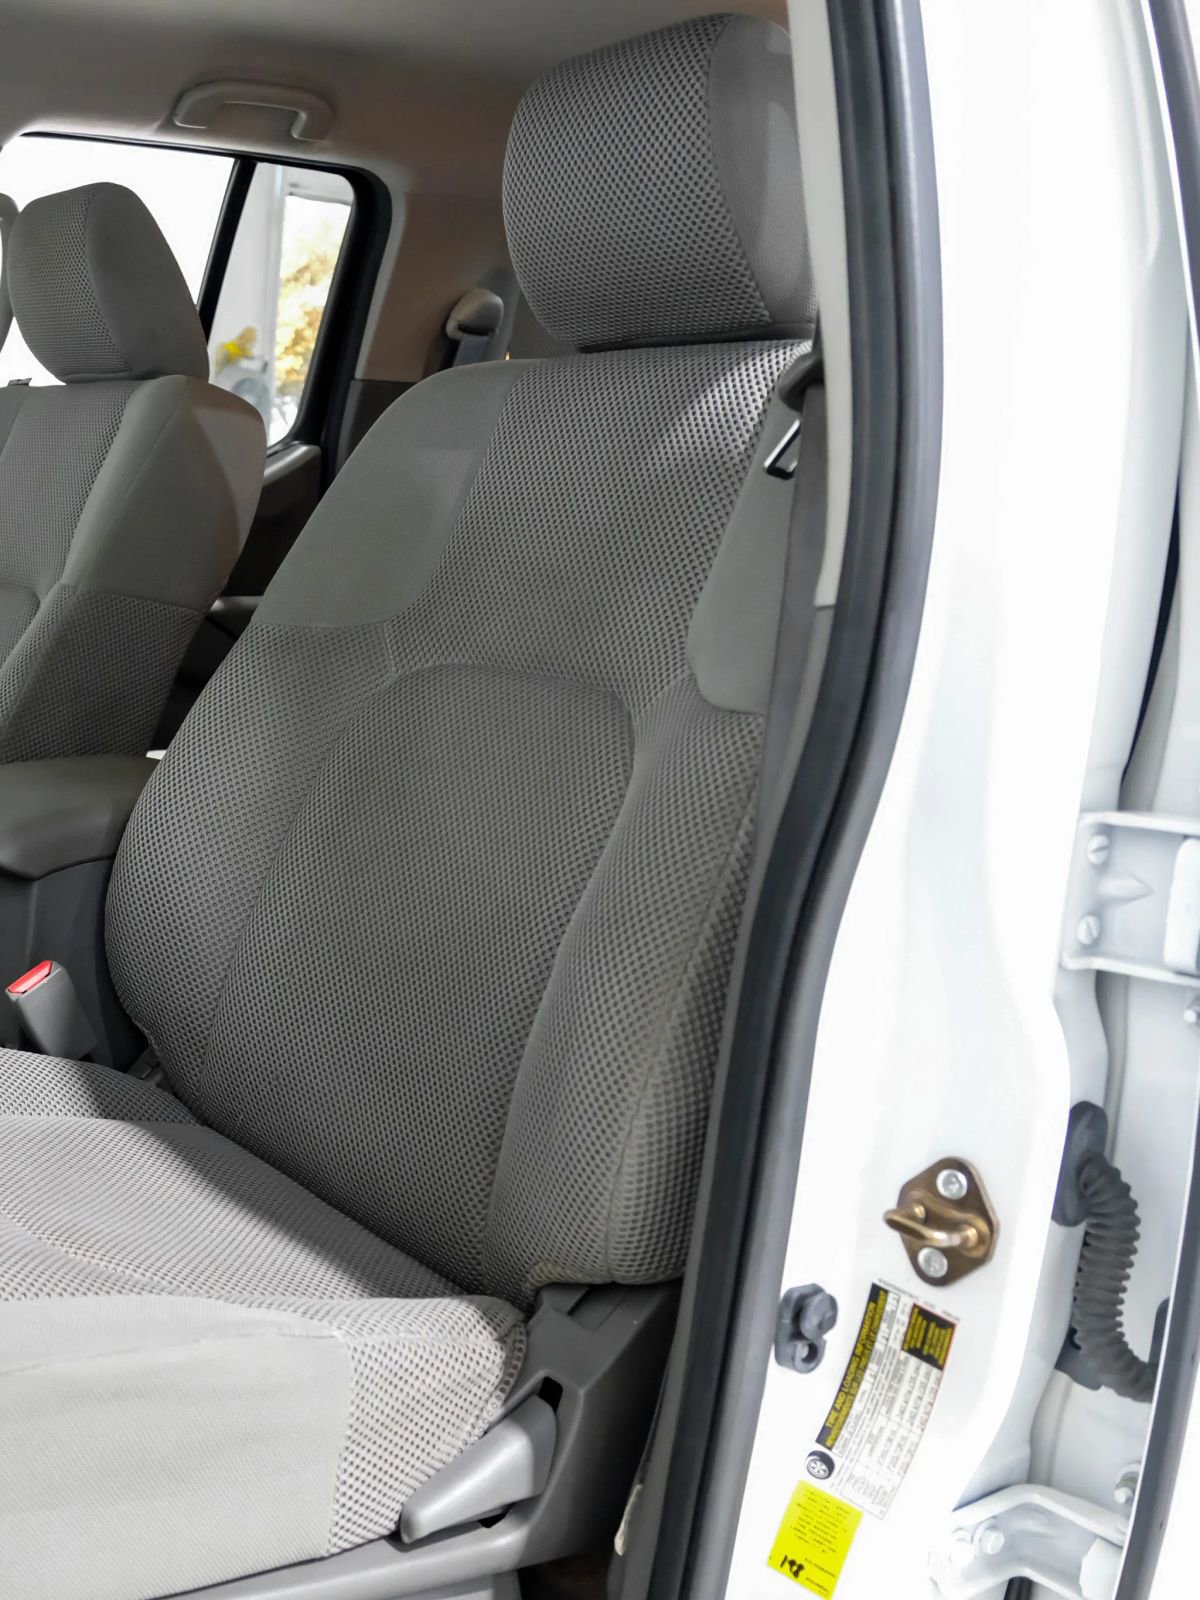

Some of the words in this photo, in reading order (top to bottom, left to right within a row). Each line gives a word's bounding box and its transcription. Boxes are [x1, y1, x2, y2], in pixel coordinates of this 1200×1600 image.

[825, 1409, 838, 1428] TIRE
[833, 1390, 846, 1409] AND
[841, 1355, 860, 1392] LOADING
